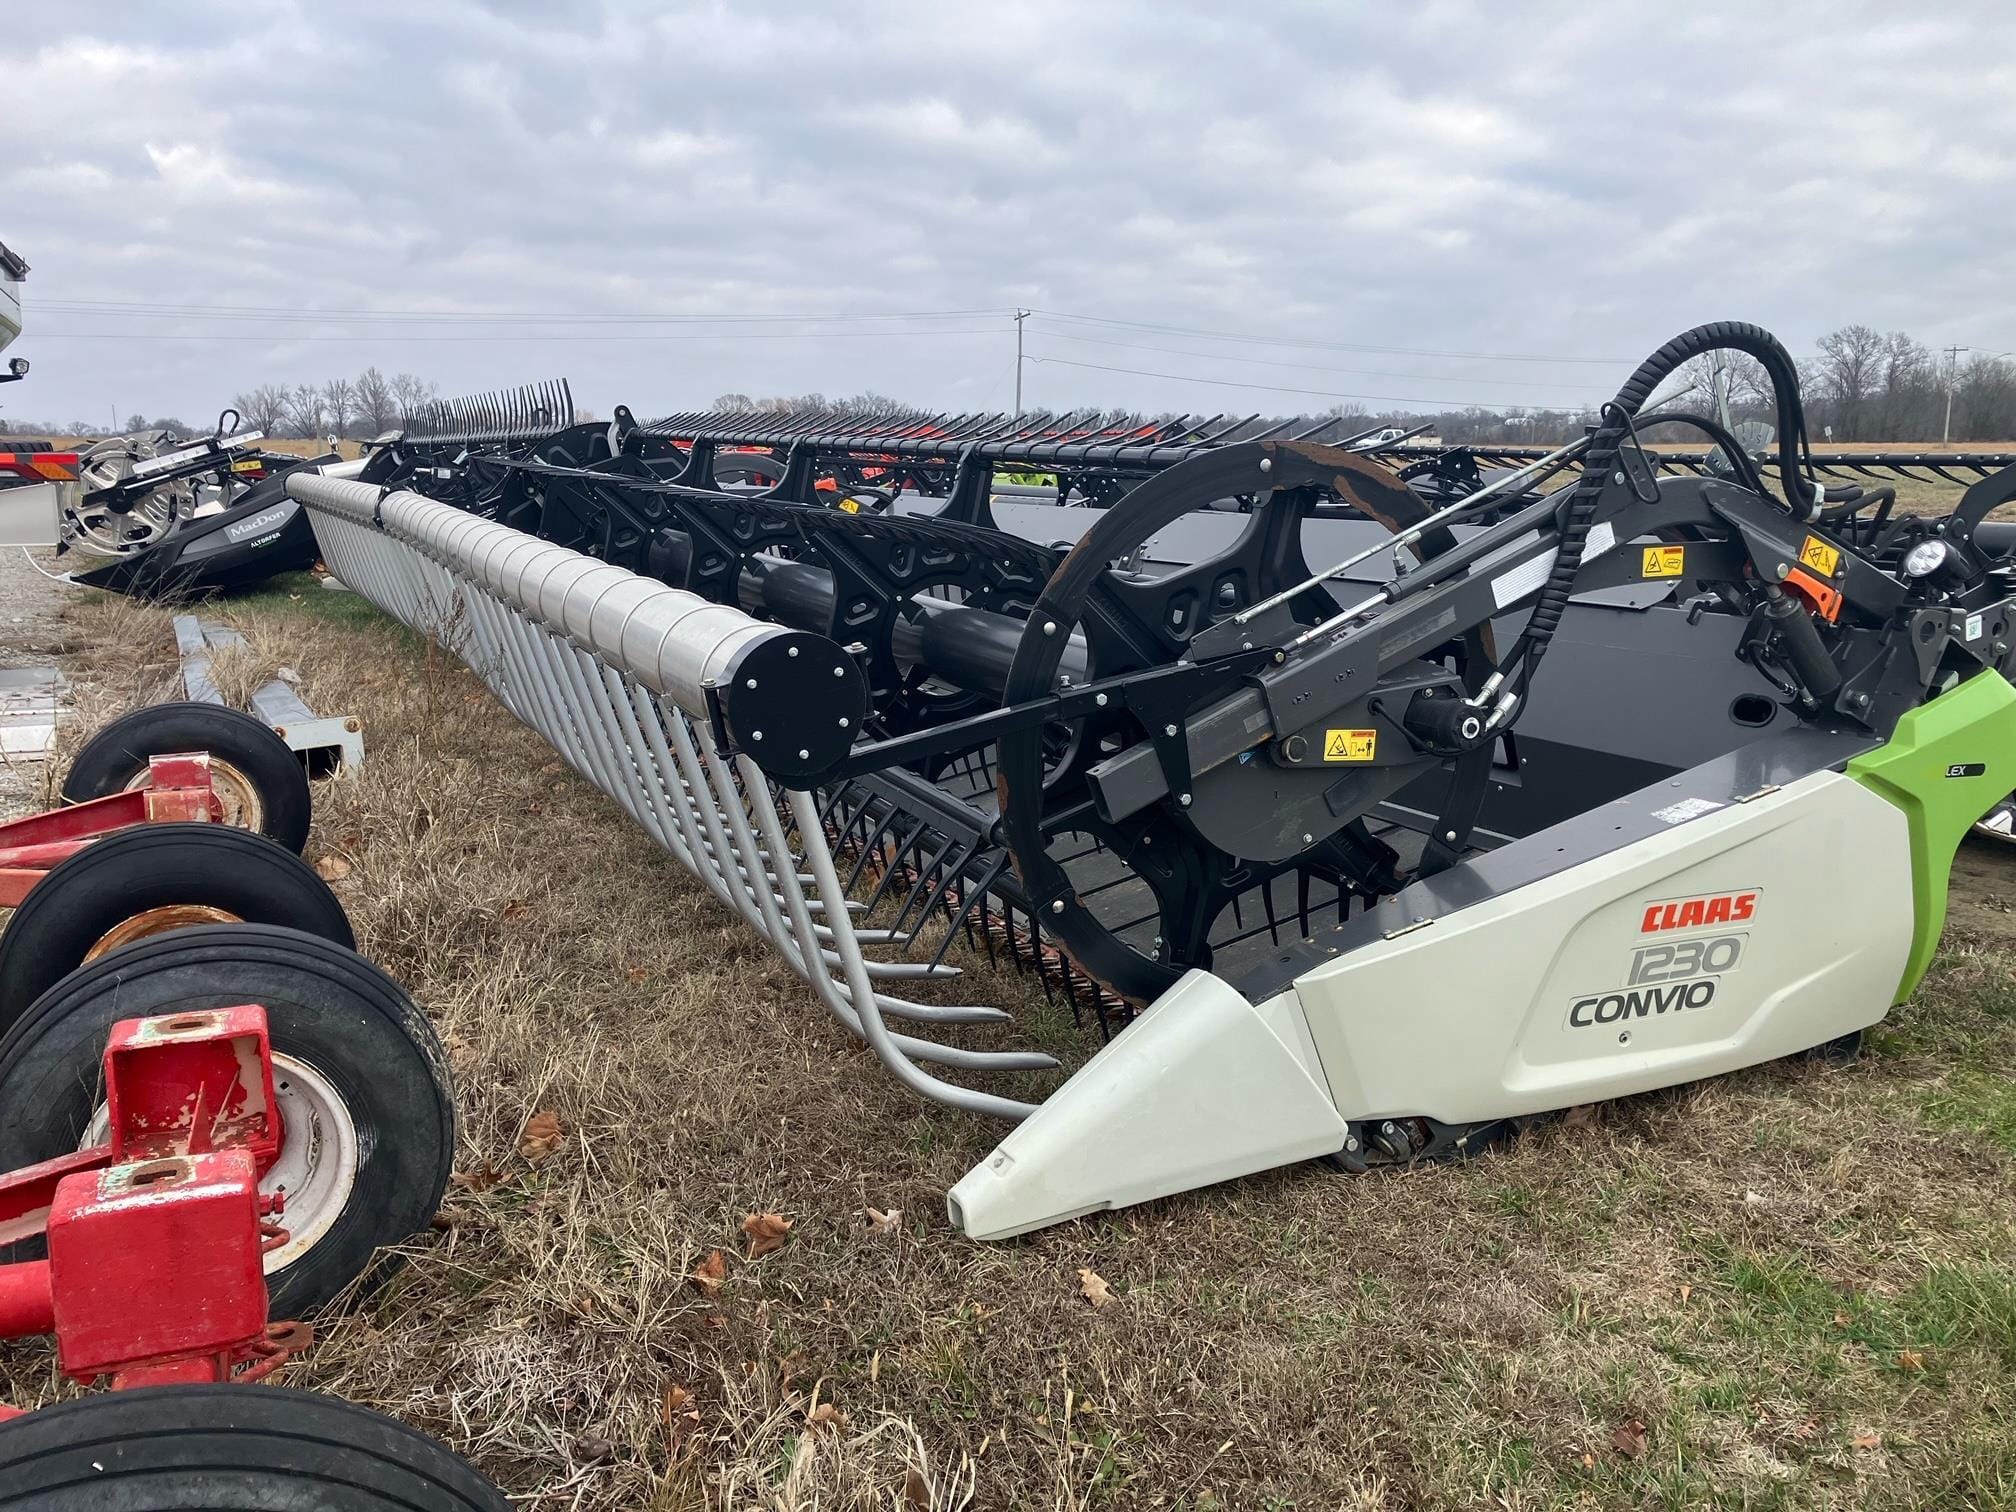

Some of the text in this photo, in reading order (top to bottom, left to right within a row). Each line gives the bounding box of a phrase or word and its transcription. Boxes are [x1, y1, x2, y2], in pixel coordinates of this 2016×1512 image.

[231, 511, 285, 537] MacDon
[251, 532, 281, 549] ALTORFER
[1641, 894, 1756, 933] CLAAS
[1628, 937, 1740, 986] 1230
[1570, 981, 1715, 1028] CONVIO
